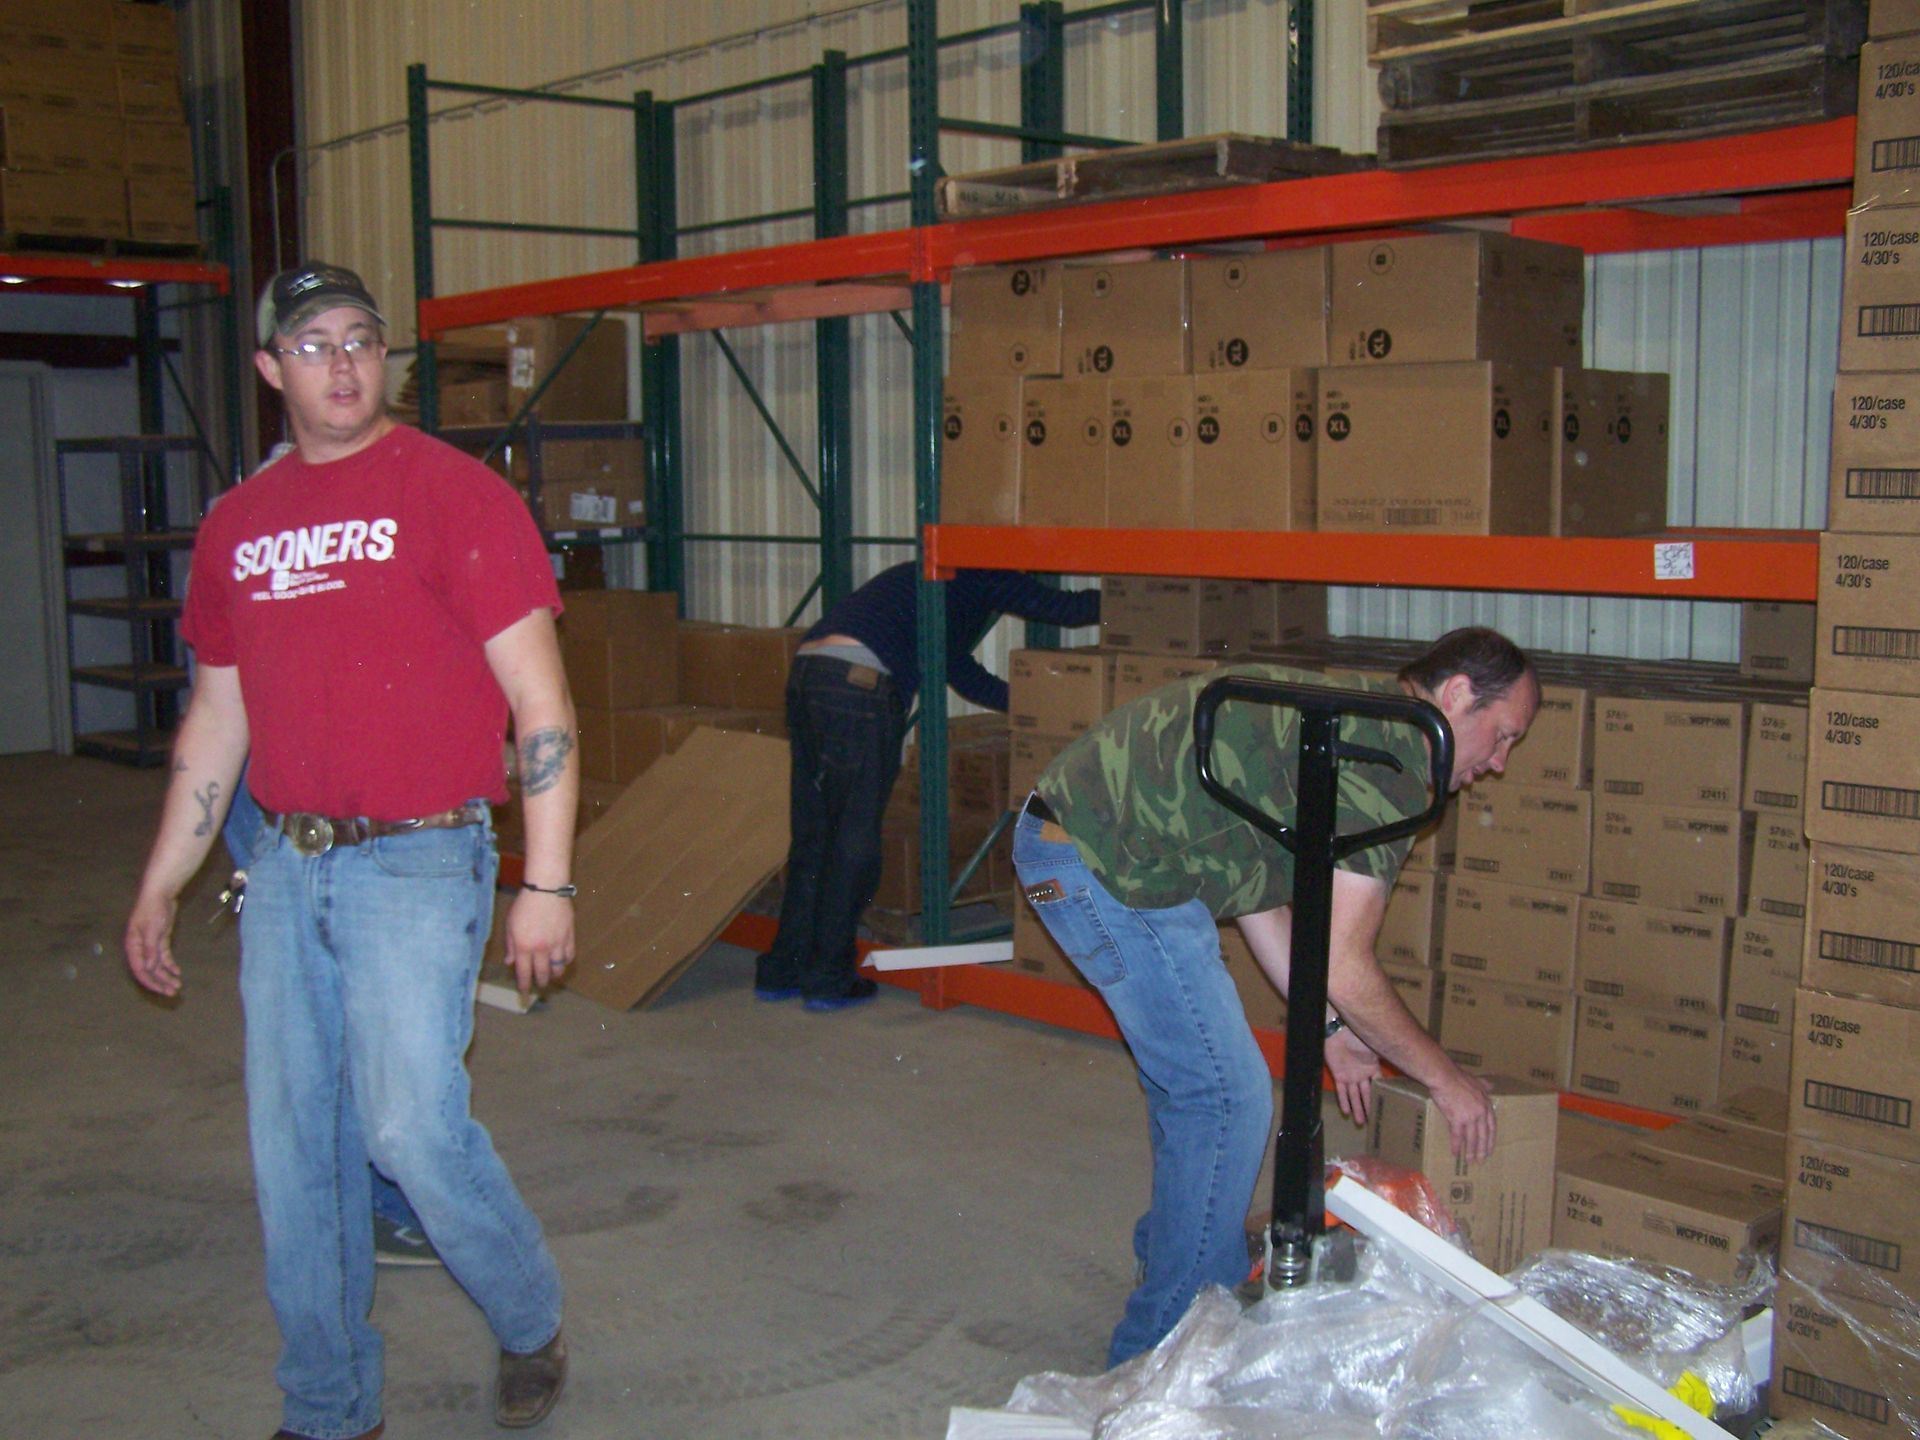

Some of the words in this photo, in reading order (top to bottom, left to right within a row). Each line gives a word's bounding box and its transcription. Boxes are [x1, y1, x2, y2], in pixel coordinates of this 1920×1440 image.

[1875, 81, 1915, 98] 4/30's
[1864, 231, 1919, 247] 120/case
[1861, 250, 1900, 265] 4/30's
[1850, 395, 1905, 411] 120/case
[1849, 413, 1887, 430] 4/30's
[233, 518, 398, 581] SOONERS
[1837, 555, 1889, 571] 120/case
[1835, 572, 1872, 588] 4/30's
[1826, 711, 1880, 730] 120/case
[1825, 729, 1862, 746] 4/30's
[1823, 863, 1875, 882] 120/case
[1822, 879, 1857, 897] 4/30's
[1809, 1013, 1861, 1035] 120/case
[1808, 1031, 1843, 1049] 4/30's
[1799, 1155, 1850, 1178] 120/case
[1798, 1172, 1833, 1192] 4/30's
[1676, 1225, 1728, 1249] WCPP1000
